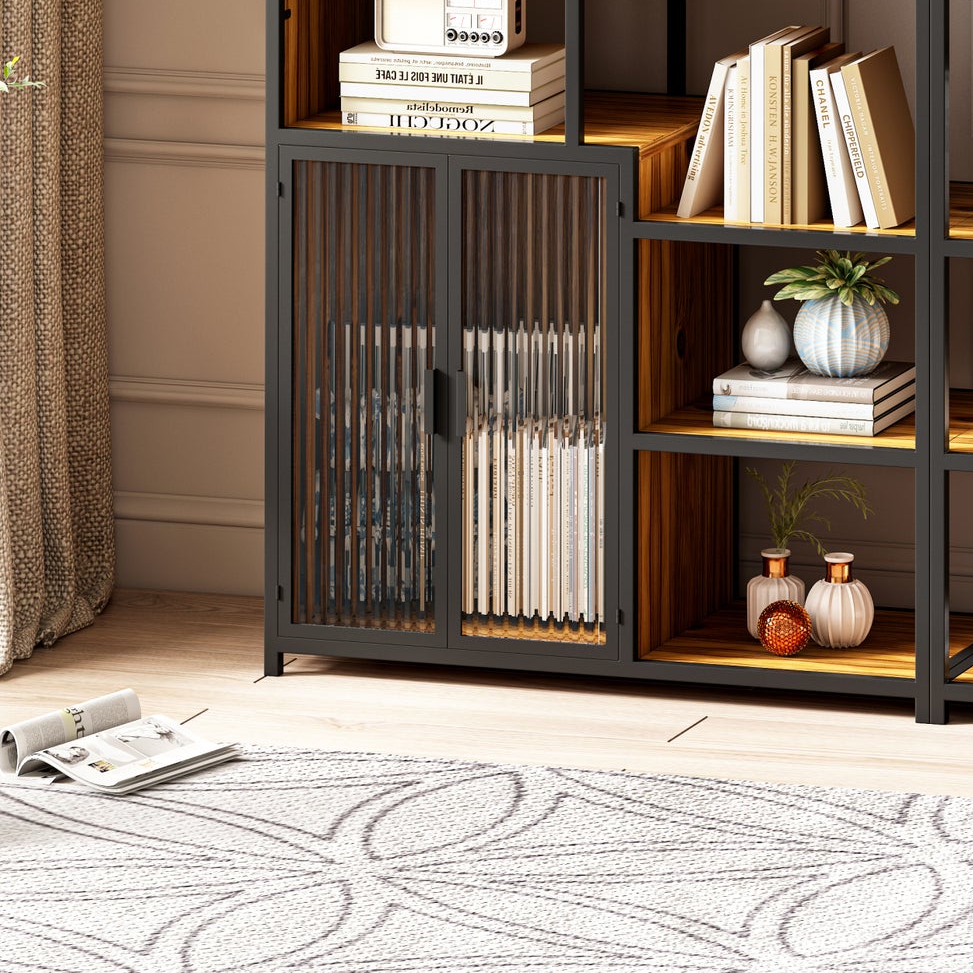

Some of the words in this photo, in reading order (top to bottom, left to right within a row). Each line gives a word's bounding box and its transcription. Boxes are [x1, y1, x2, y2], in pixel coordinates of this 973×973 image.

[700, 94, 717, 138] AVEDON
[740, 87, 748, 109] Home
[768, 75, 778, 127] KONSTEN
[816, 79, 831, 129] CHANEL
[688, 132, 706, 181] advertising
[740, 121, 748, 147] Joshua
[740, 149, 748, 165] Tree
[842, 114, 865, 179] CHIPPERFIELD
